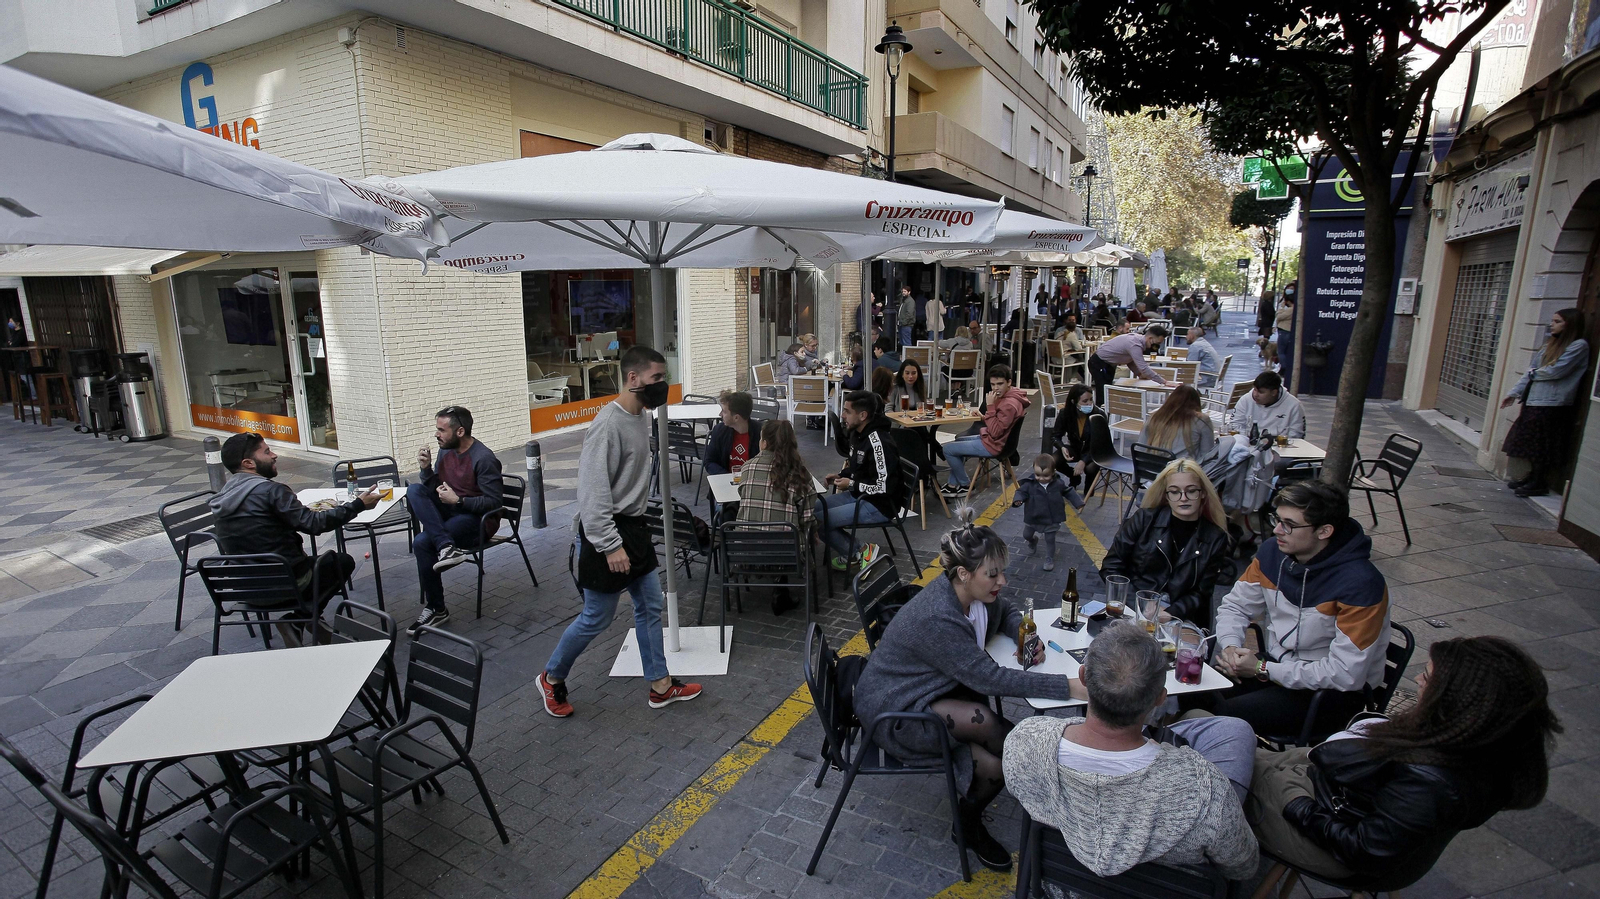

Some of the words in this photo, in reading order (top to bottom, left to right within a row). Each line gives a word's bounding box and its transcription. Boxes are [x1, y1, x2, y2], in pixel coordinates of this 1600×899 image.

[865, 199, 976, 228] Cruzcampo
[882, 220, 950, 239] ESPECIAL
[1326, 230, 1357, 239] Impresión
[1027, 229, 1084, 243] Cruzcampo
[1034, 241, 1070, 252] ESPECIAL
[1346, 242, 1365, 250] forma
[1324, 253, 1352, 262] Imprenta
[1329, 276, 1363, 284] Rotulación
[1340, 288, 1363, 296] Lumino
[1330, 300, 1355, 308] Displays
[1335, 312, 1340, 320] y
[1340, 311, 1358, 321] Regal
[198, 411, 294, 436] www.inmobiliariagesting.com
[874, 446, 884, 470] Space
